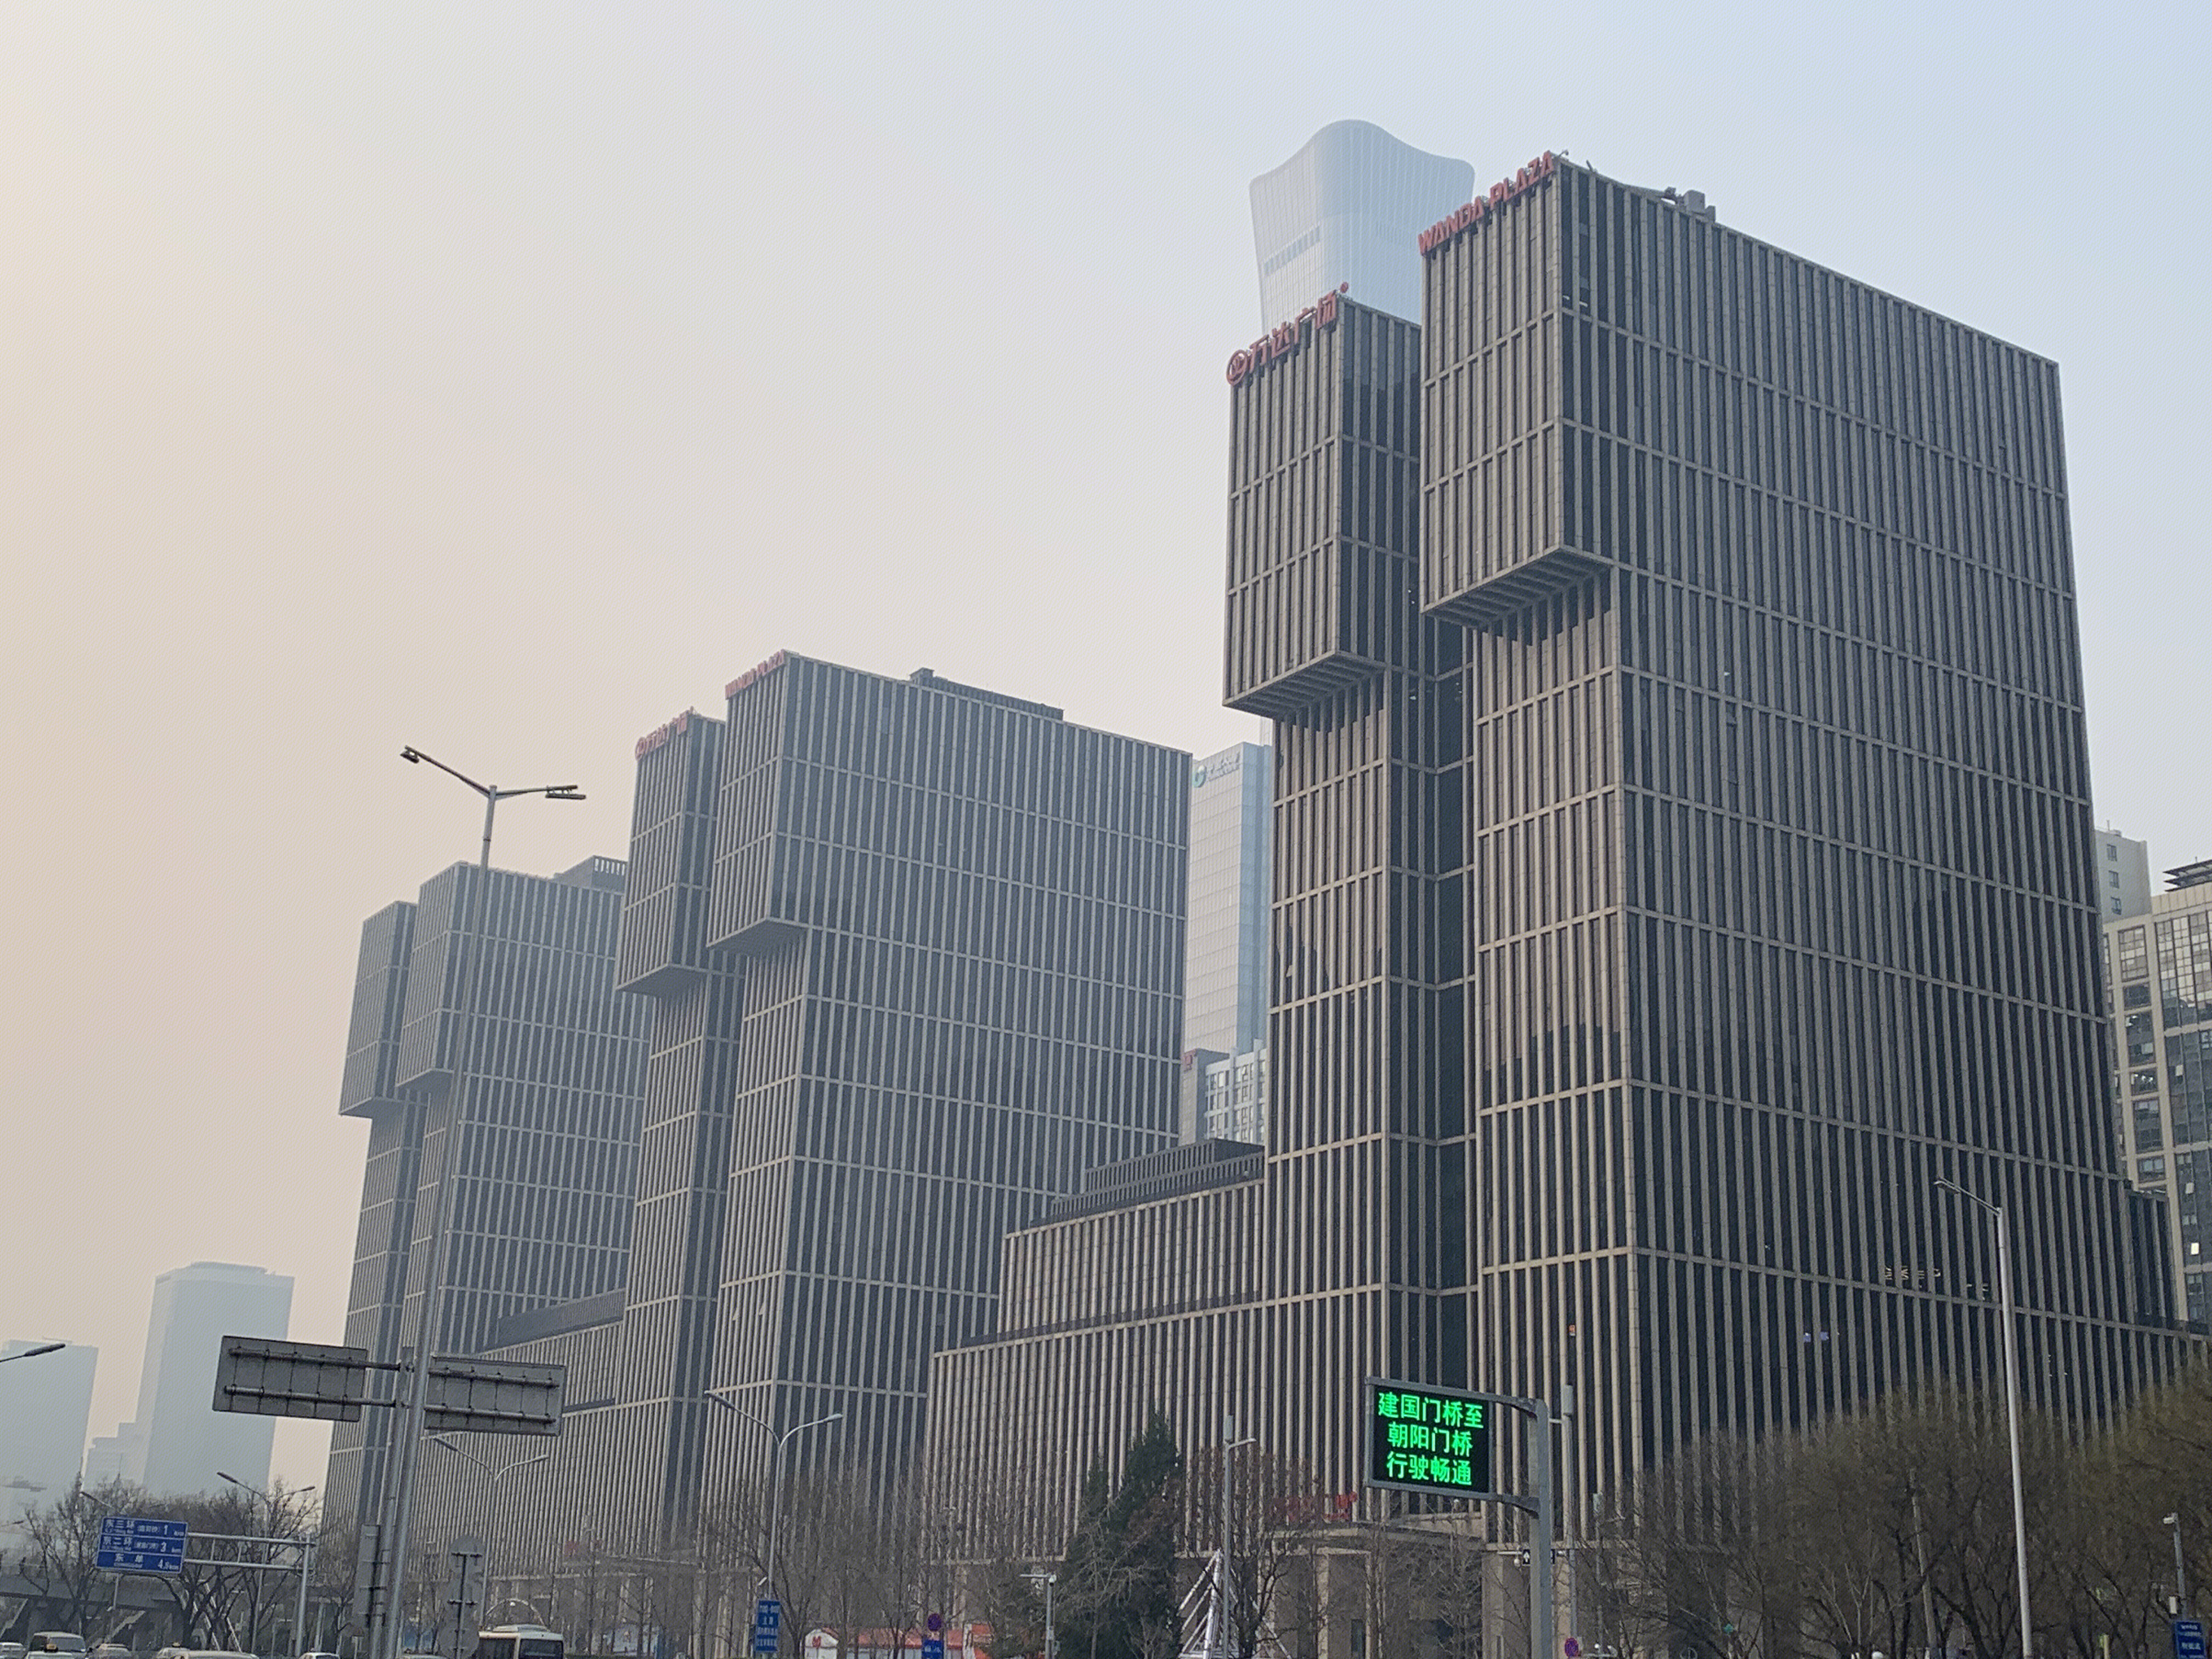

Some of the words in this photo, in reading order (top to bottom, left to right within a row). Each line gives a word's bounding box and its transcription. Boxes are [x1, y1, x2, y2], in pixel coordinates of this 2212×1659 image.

[1418, 196, 1485, 255] WANDA
[1489, 150, 1554, 210] PLAZA
[1249, 289, 1338, 374] 万达广场
[1378, 1391, 1483, 1429] 建国门桥至
[1387, 1421, 1473, 1457] 朝阳门桥
[1386, 1451, 1472, 1486] 行驶畅通
[164, 1525, 168, 1535] 1
